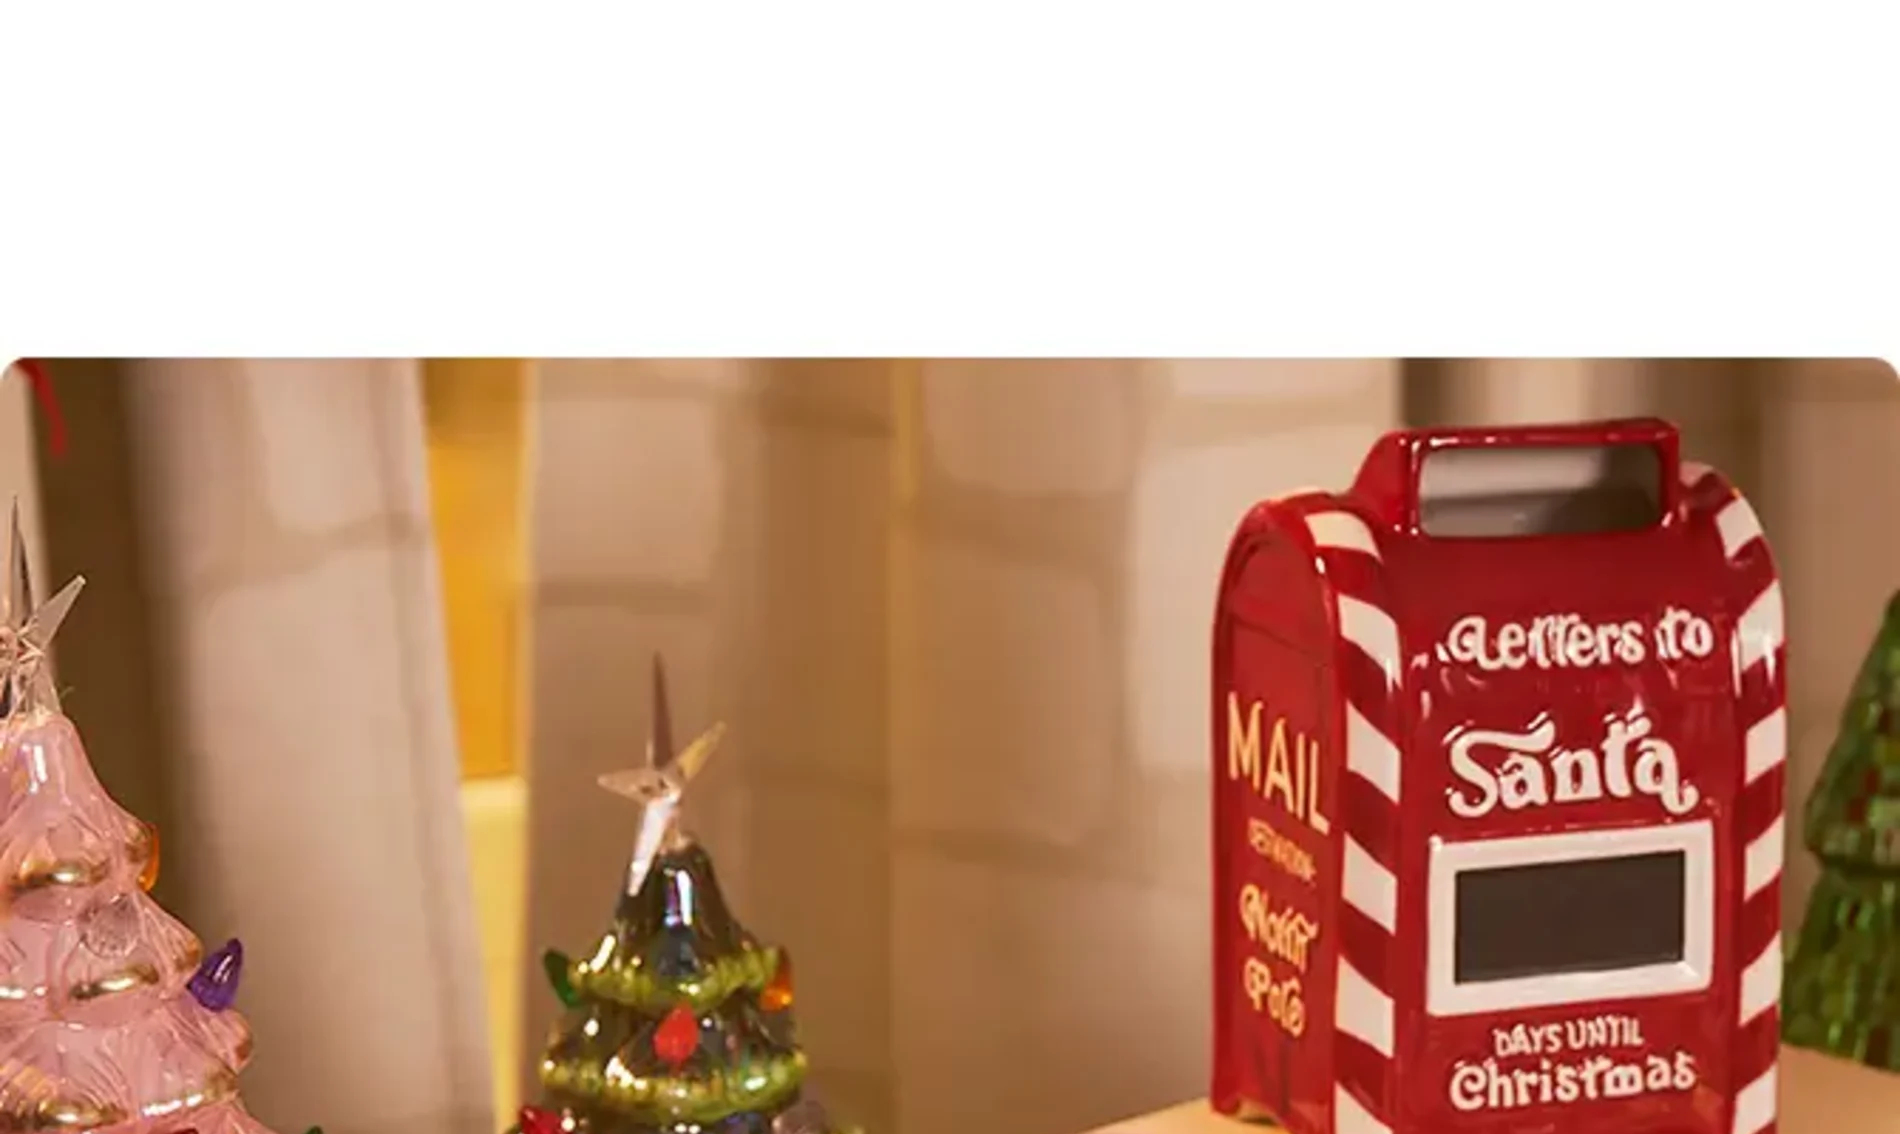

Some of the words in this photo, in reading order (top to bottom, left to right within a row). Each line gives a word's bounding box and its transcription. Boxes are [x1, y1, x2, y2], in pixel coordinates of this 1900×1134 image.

[1446, 614, 1646, 670] Letters
[1656, 606, 1714, 658] to
[1227, 691, 1329, 835] MAIL
[1446, 708, 1699, 817] Santa
[1494, 1022, 1562, 1057] DAYS
[1567, 1014, 1644, 1051] UNTIL
[1449, 1053, 1696, 1111] Christmas
